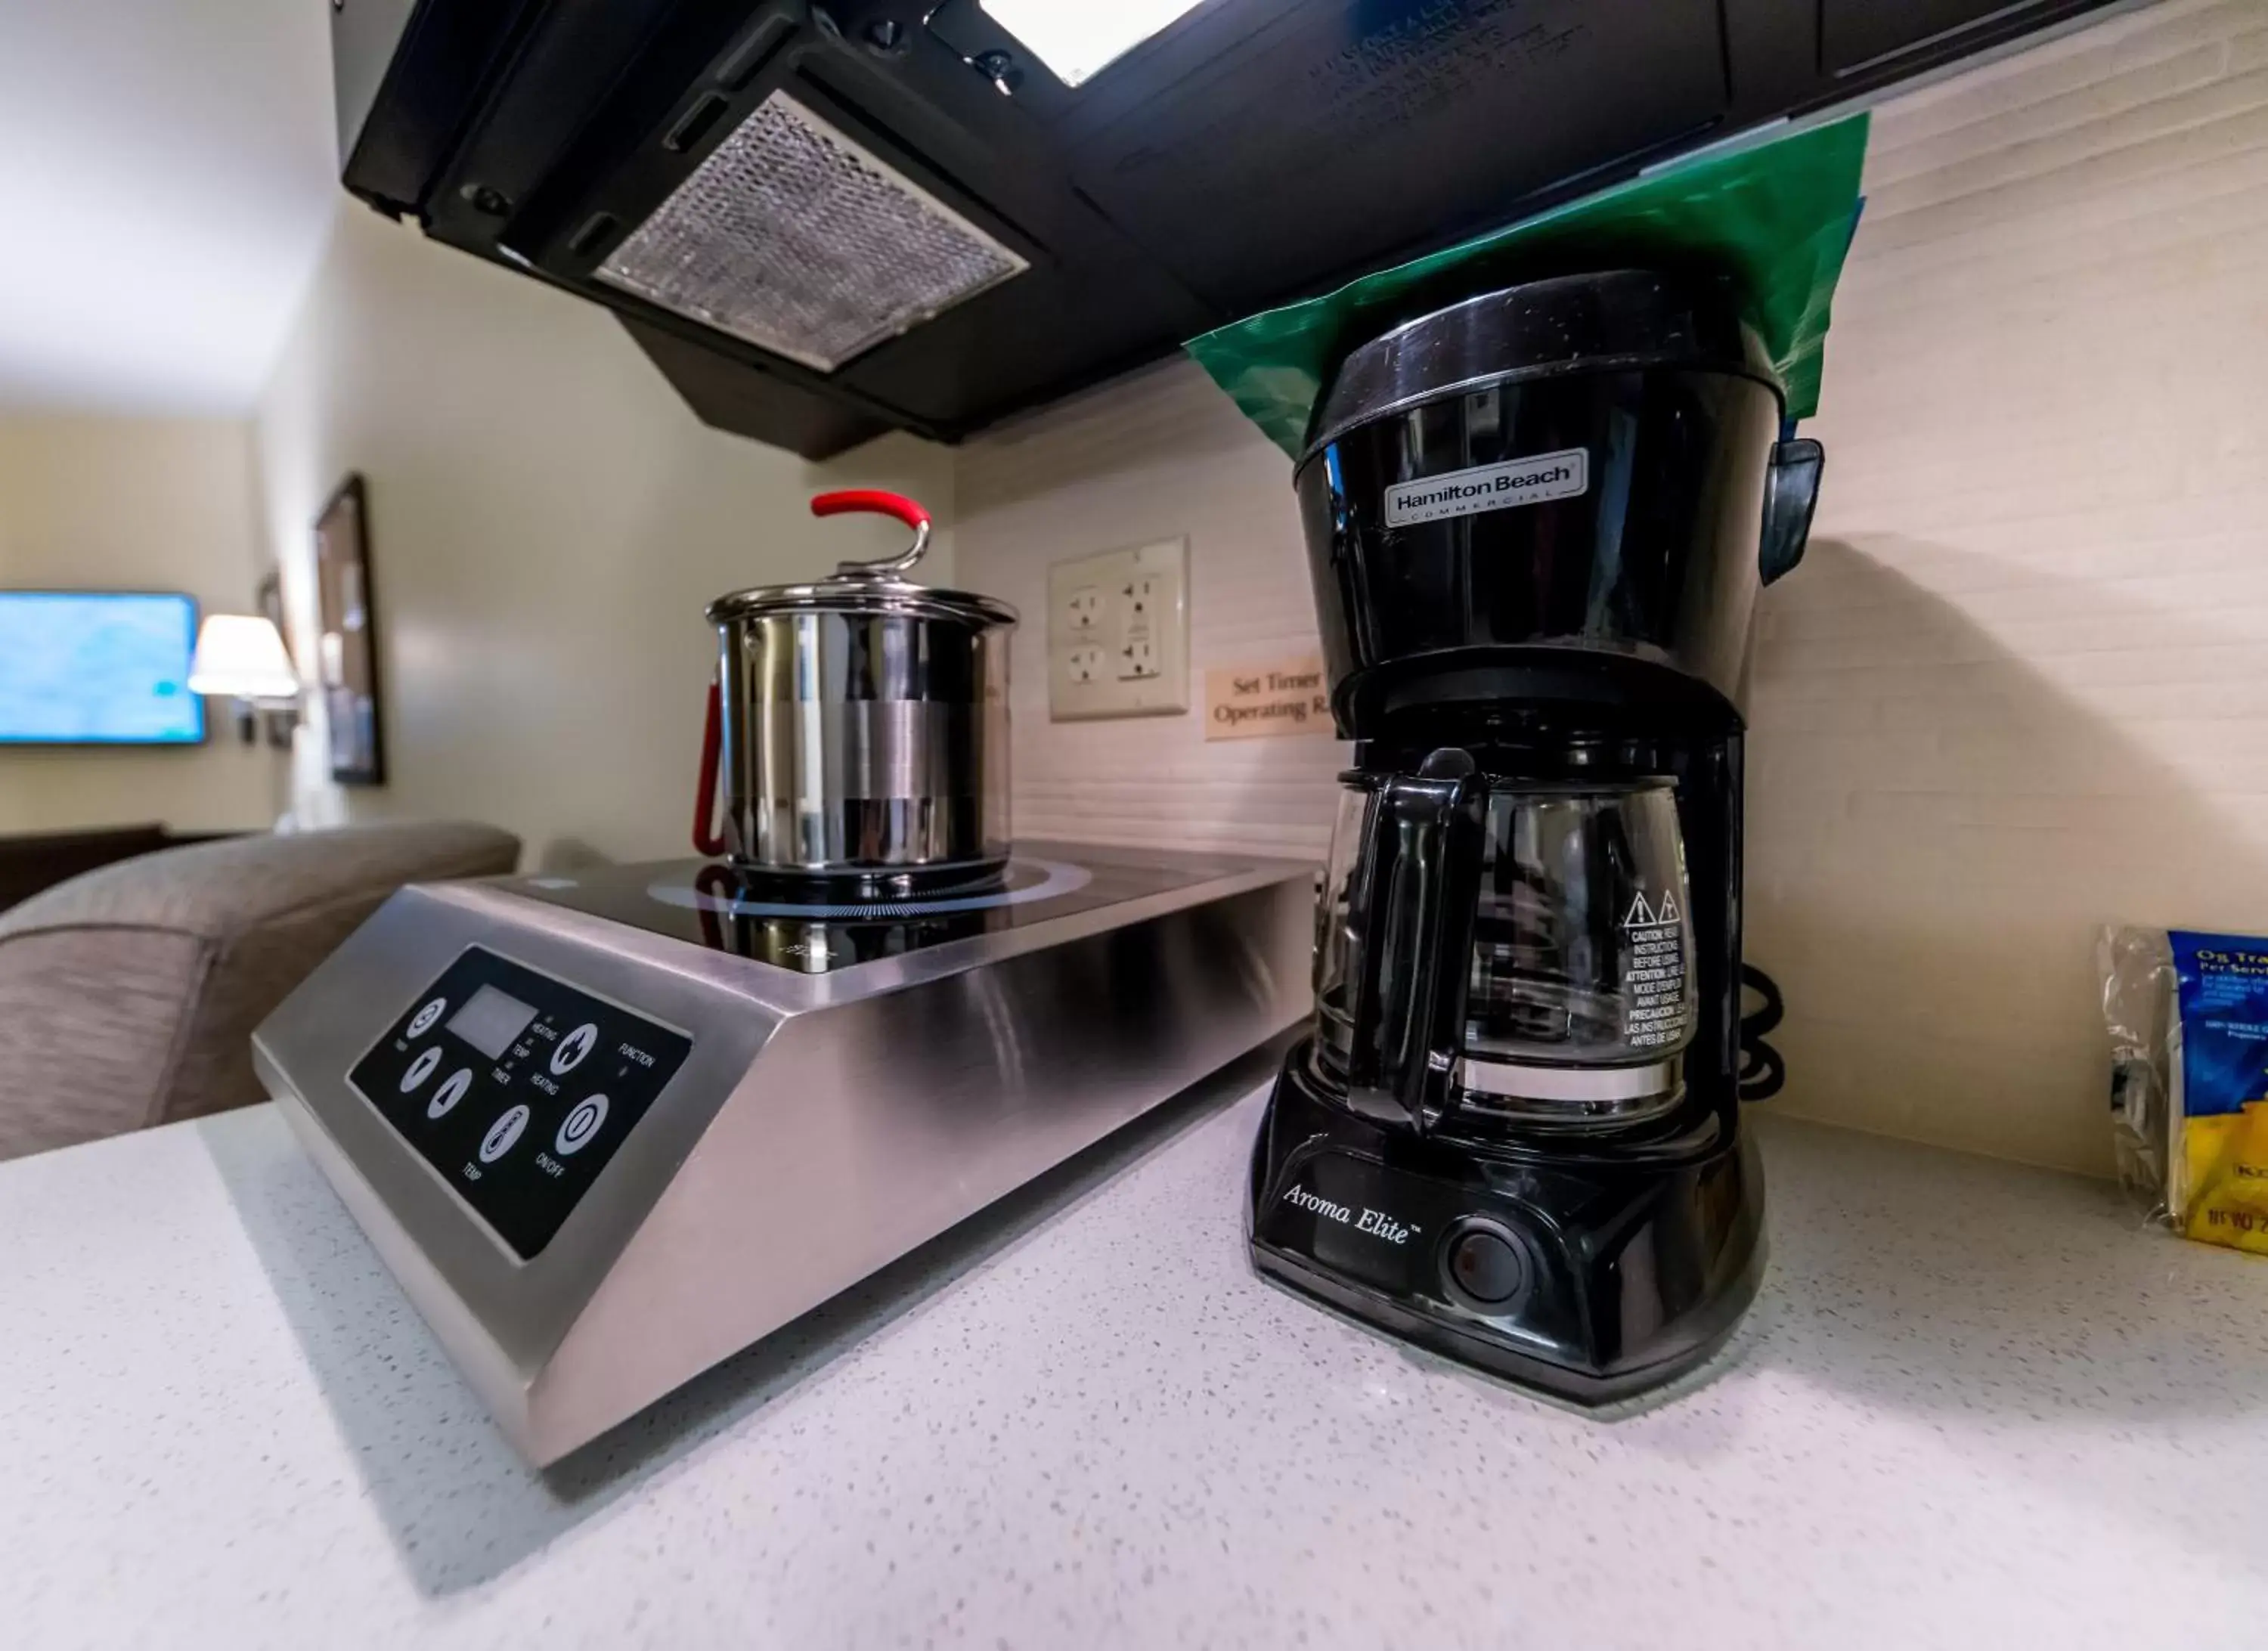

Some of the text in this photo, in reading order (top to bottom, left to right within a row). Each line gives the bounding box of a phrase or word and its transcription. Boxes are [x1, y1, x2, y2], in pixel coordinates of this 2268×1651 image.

[1398, 465, 1570, 511] Hamilton Beach
[1410, 490, 1554, 521] COMMERCIAL
[1233, 671, 1321, 696] Set Timer
[1213, 702, 1307, 726] Operating
[1634, 955, 1661, 968] BEFORE
[1623, 1021, 1639, 1035] LAS
[1631, 1033, 1656, 1047] ANTES
[1656, 1031, 1665, 1043] DE
[618, 1042, 656, 1068] FUNCTION
[463, 1161, 482, 1181] TEMP
[1283, 1183, 1349, 1224] Aroma
